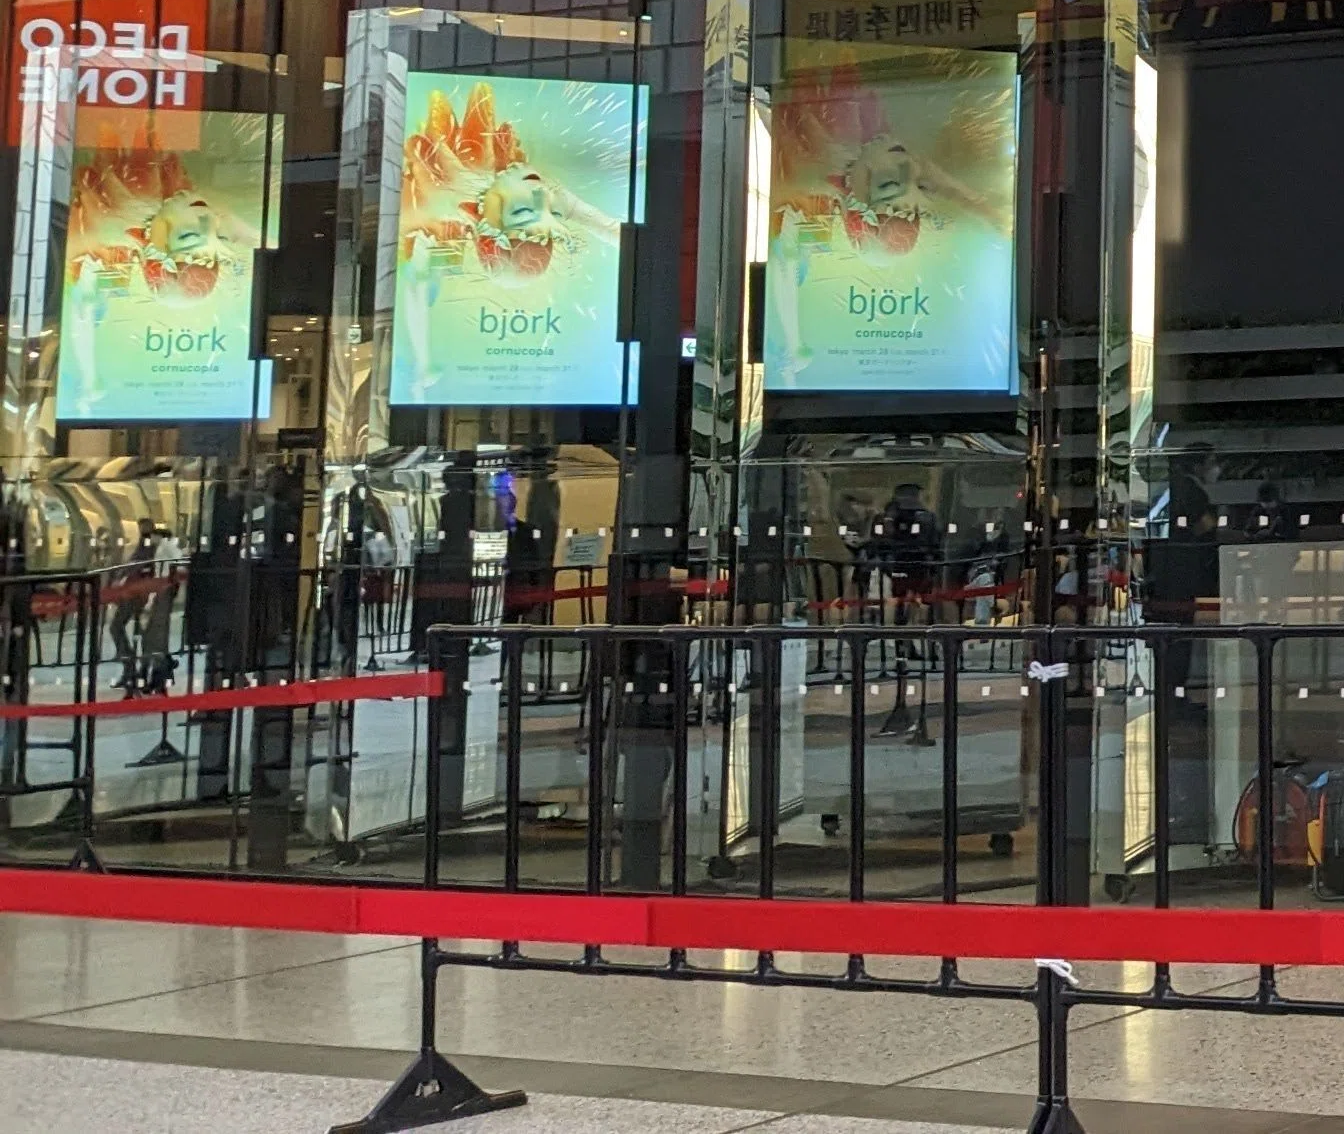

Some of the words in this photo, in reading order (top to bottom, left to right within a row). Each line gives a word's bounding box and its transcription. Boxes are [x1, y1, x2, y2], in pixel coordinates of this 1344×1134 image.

[849, 286, 930, 322] björk
[480, 306, 561, 341] björk
[855, 329, 923, 340] cornucopia
[145, 326, 226, 359] björk
[486, 347, 554, 357] cornucopia
[151, 363, 220, 374] cornucopia
